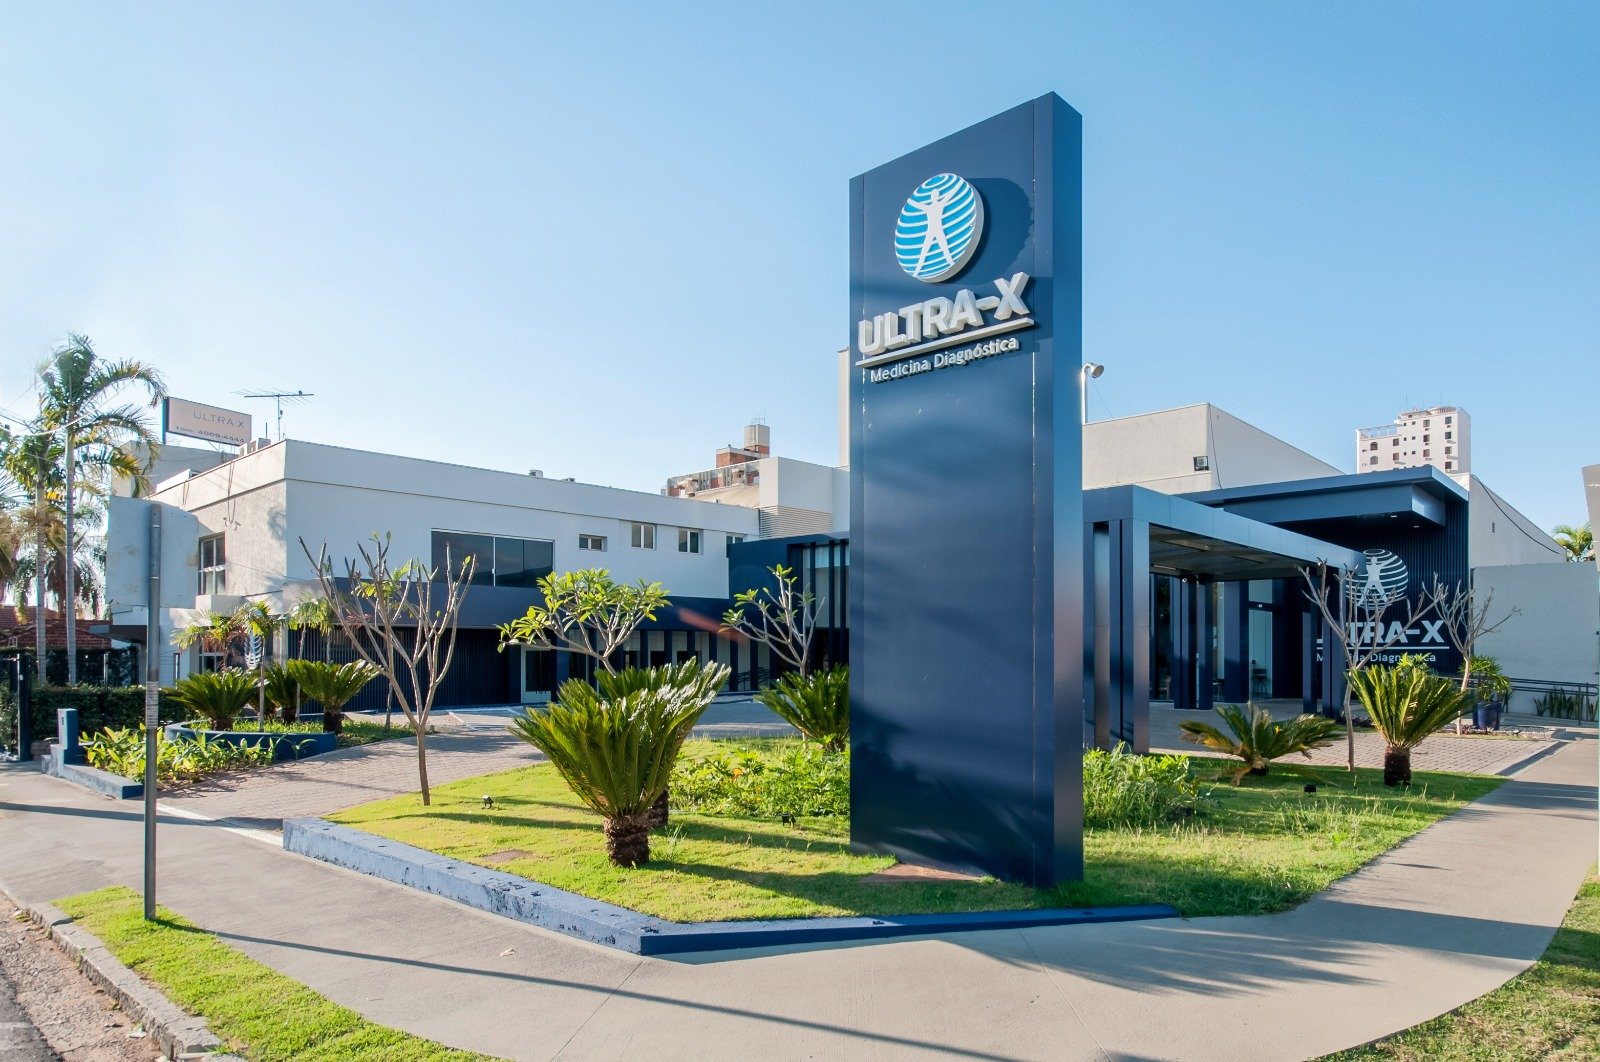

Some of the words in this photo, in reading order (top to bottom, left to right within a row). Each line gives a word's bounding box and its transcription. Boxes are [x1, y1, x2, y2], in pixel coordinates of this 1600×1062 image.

[858, 271, 1031, 355] ULTRA-X
[870, 359, 931, 383] Medicina
[934, 337, 1020, 368] Diagnóstica
[1317, 620, 1445, 644] TRA-X
[1370, 653, 1436, 663] Diagnsca
